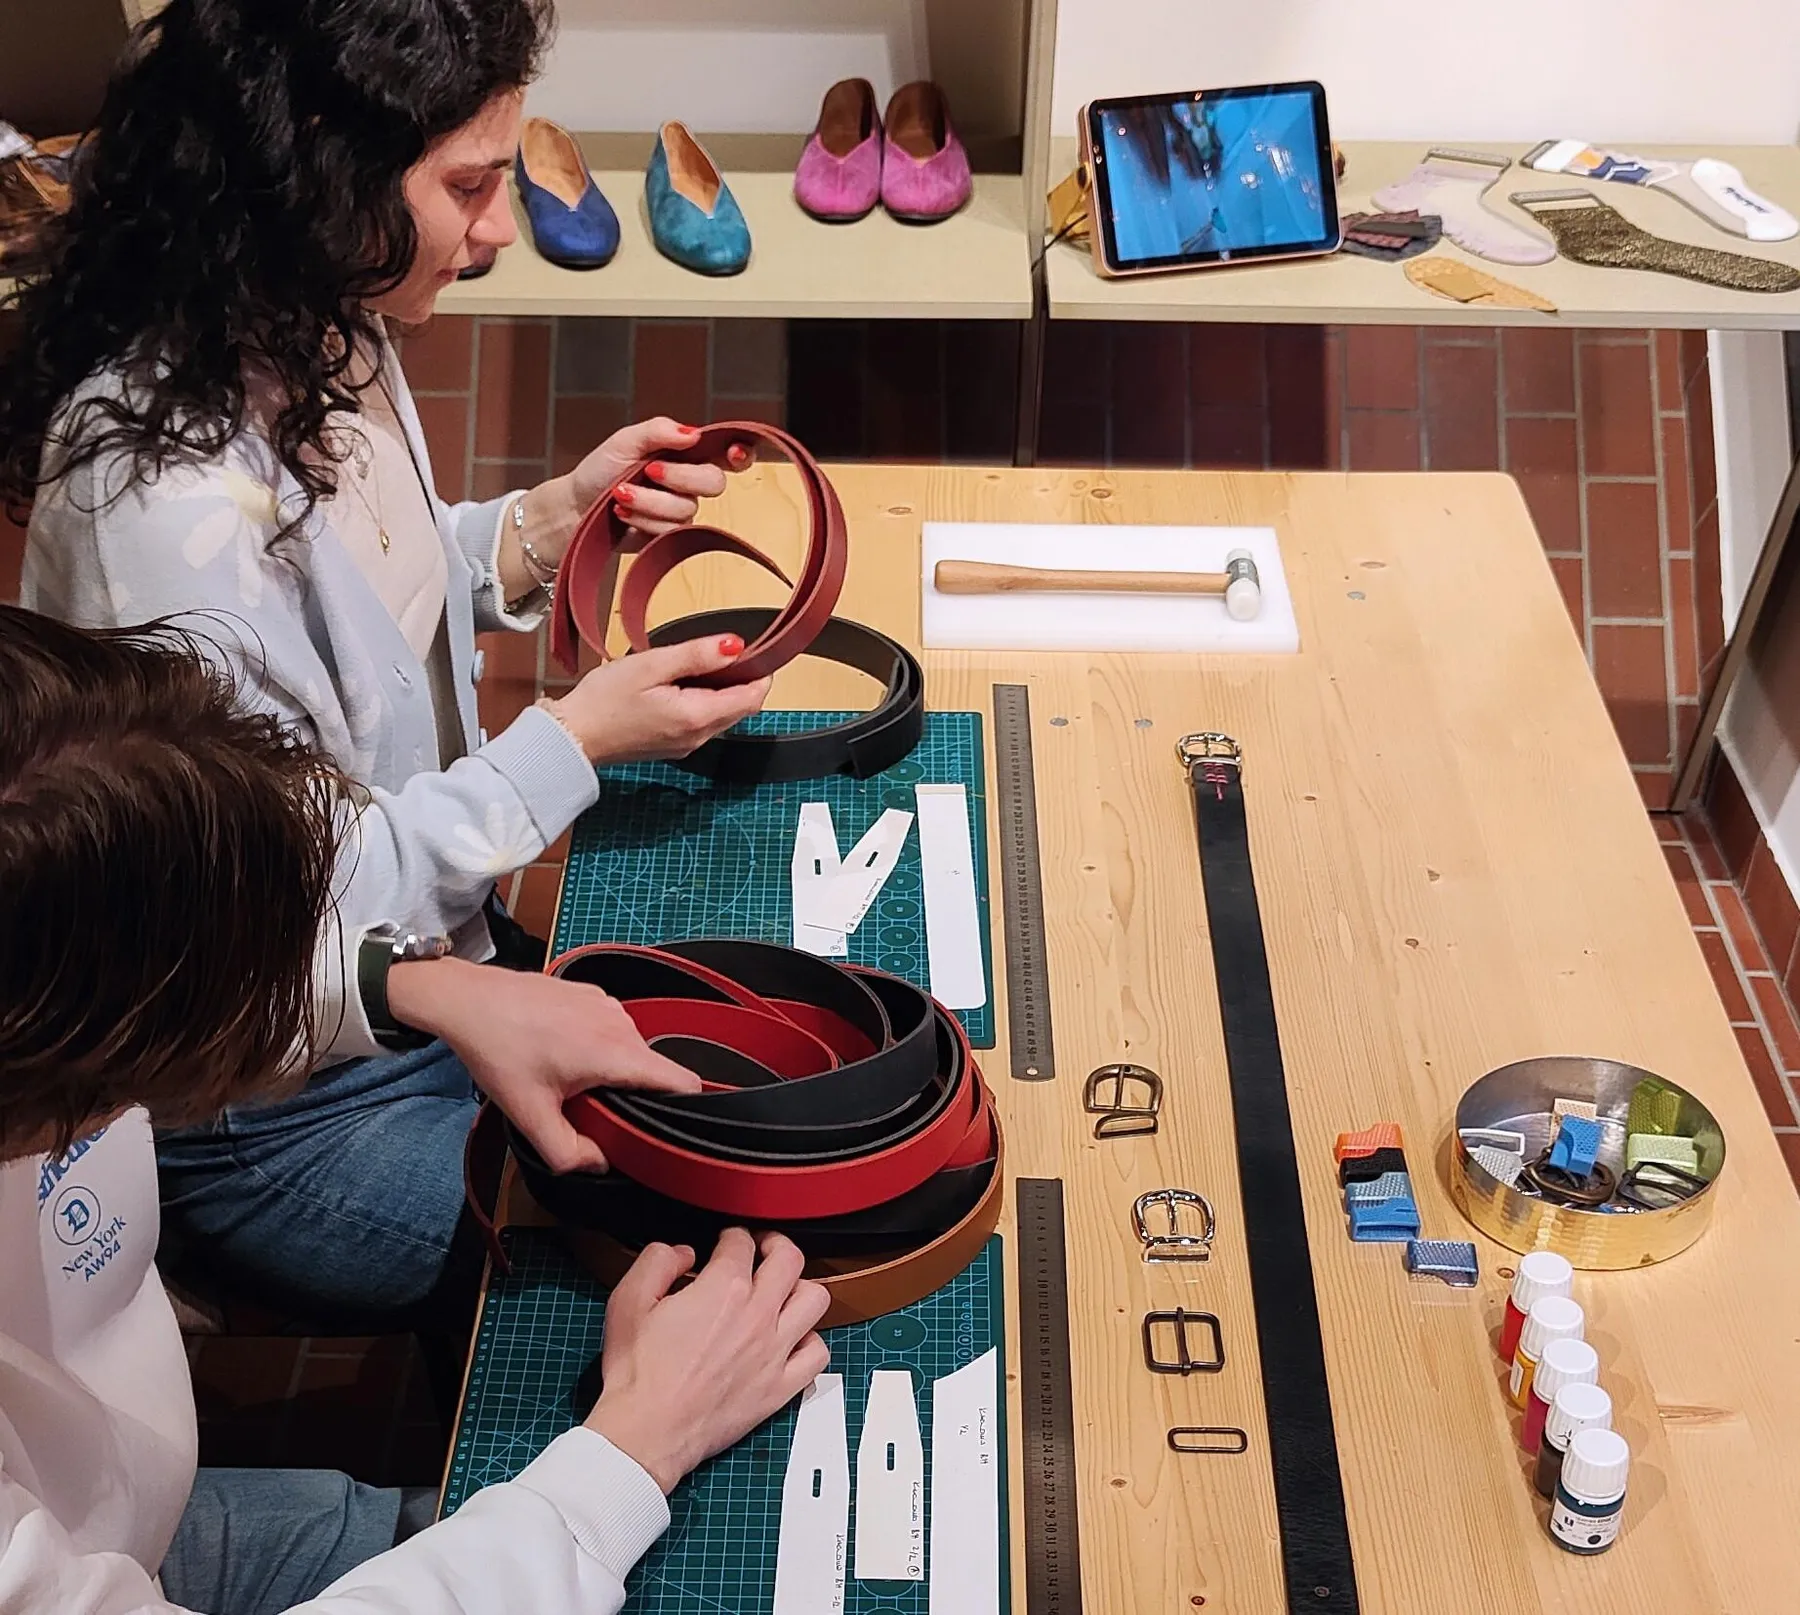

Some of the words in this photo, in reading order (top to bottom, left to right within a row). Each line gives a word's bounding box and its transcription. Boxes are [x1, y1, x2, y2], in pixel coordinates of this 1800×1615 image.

[60, 1199, 89, 1237] D
[62, 1246, 93, 1280] New
[93, 1216, 127, 1249] York
[85, 1240, 121, 1282] AW94
[1041, 1394, 1053, 1405] 20
[1042, 1407, 1052, 1415] 21
[1042, 1420, 1053, 1428] 22
[1042, 1432, 1053, 1441] 23
[1043, 1444, 1054, 1453] 24
[1043, 1457, 1054, 1466] 25
[1044, 1469, 1055, 1480] 26
[1044, 1482, 1055, 1492] 27
[1045, 1496, 1056, 1505] 28
[1045, 1509, 1056, 1519] 29
[1045, 1521, 1057, 1533] 30
[1045, 1535, 1057, 1545] 31
[909, 1546, 919, 1562] 2/2
[1046, 1549, 1058, 1559] 32
[1046, 1563, 1058, 1573] 33
[1047, 1577, 1058, 1587] 34
[1048, 1591, 1059, 1601] 35
